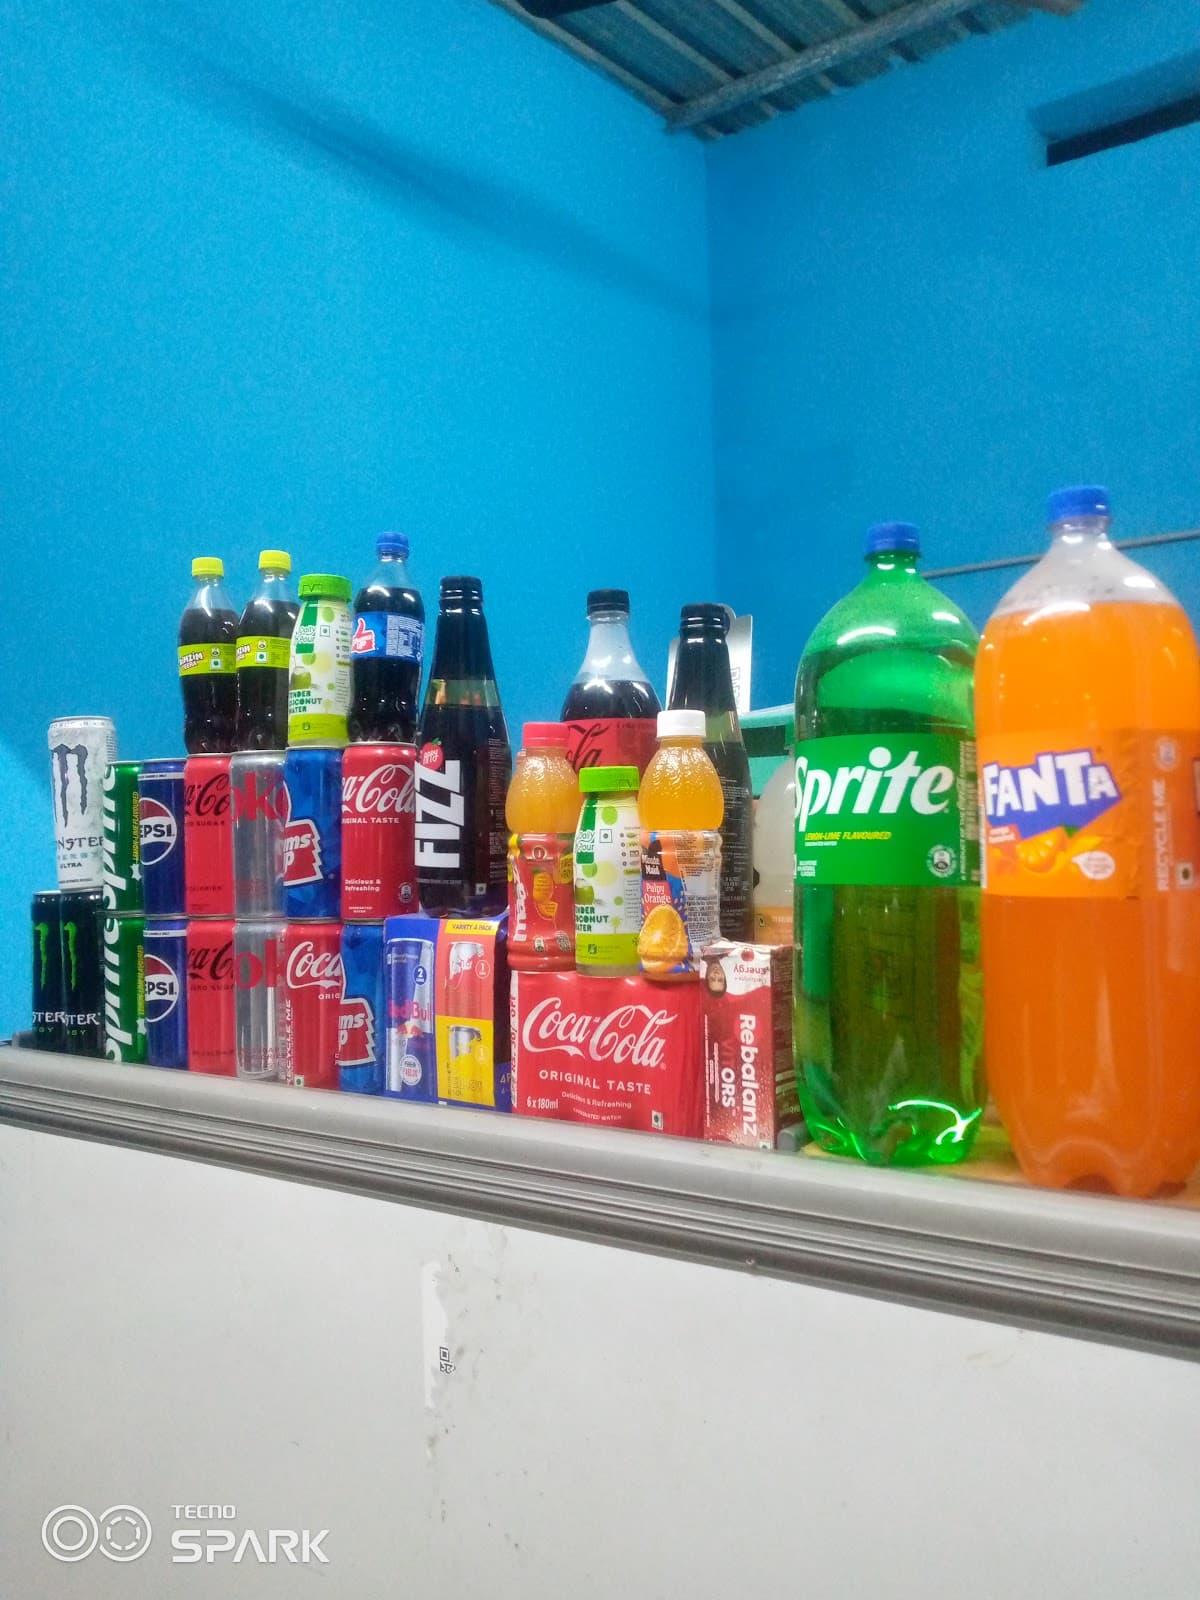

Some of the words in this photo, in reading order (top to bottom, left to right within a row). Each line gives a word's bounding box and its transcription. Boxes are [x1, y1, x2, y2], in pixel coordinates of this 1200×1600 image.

[794, 746, 955, 832] Sprite
[982, 751, 1119, 816] FANTA
[414, 760, 464, 868] FIZZ
[644, 893, 672, 905] Orange
[646, 882, 665, 895] Pulpy
[417, 968, 424, 979] 2
[734, 963, 768, 976] Energy
[522, 997, 678, 1068] Coca-Cola
[539, 1069, 600, 1090] ORIGINAL
[606, 1079, 651, 1095] TASTE
[739, 1014, 759, 1136] Rebalanz
